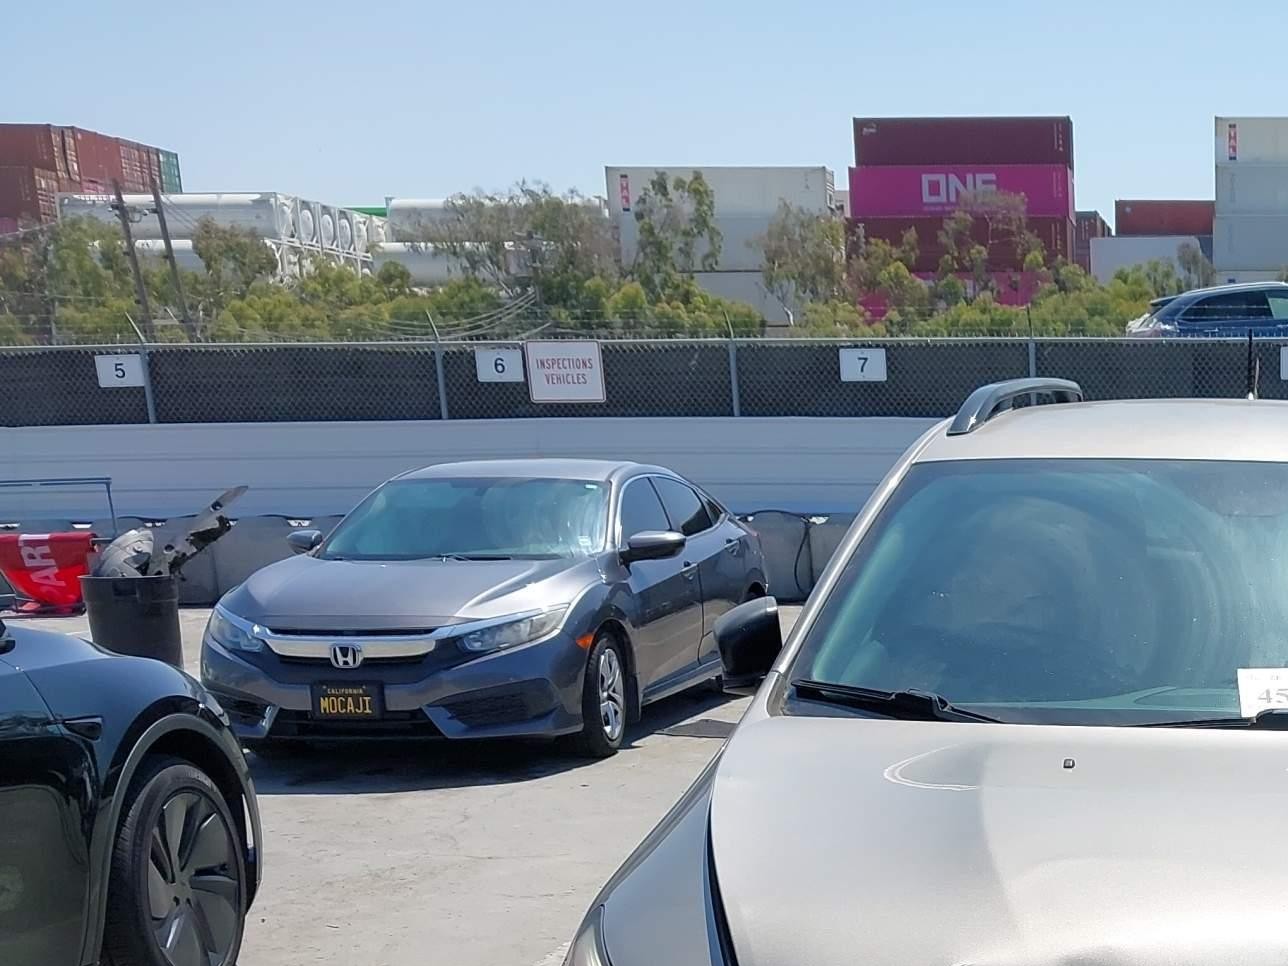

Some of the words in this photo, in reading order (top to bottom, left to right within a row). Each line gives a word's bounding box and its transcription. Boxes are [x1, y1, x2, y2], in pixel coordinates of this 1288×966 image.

[921, 173, 997, 203] ONE
[115, 363, 126, 379] 5
[494, 357, 506, 374] 6
[536, 358, 593, 370] INSPECTIONS
[857, 356, 869, 373] 7
[545, 373, 588, 385] VEHICLES
[320, 696, 373, 714] MOCAJI
